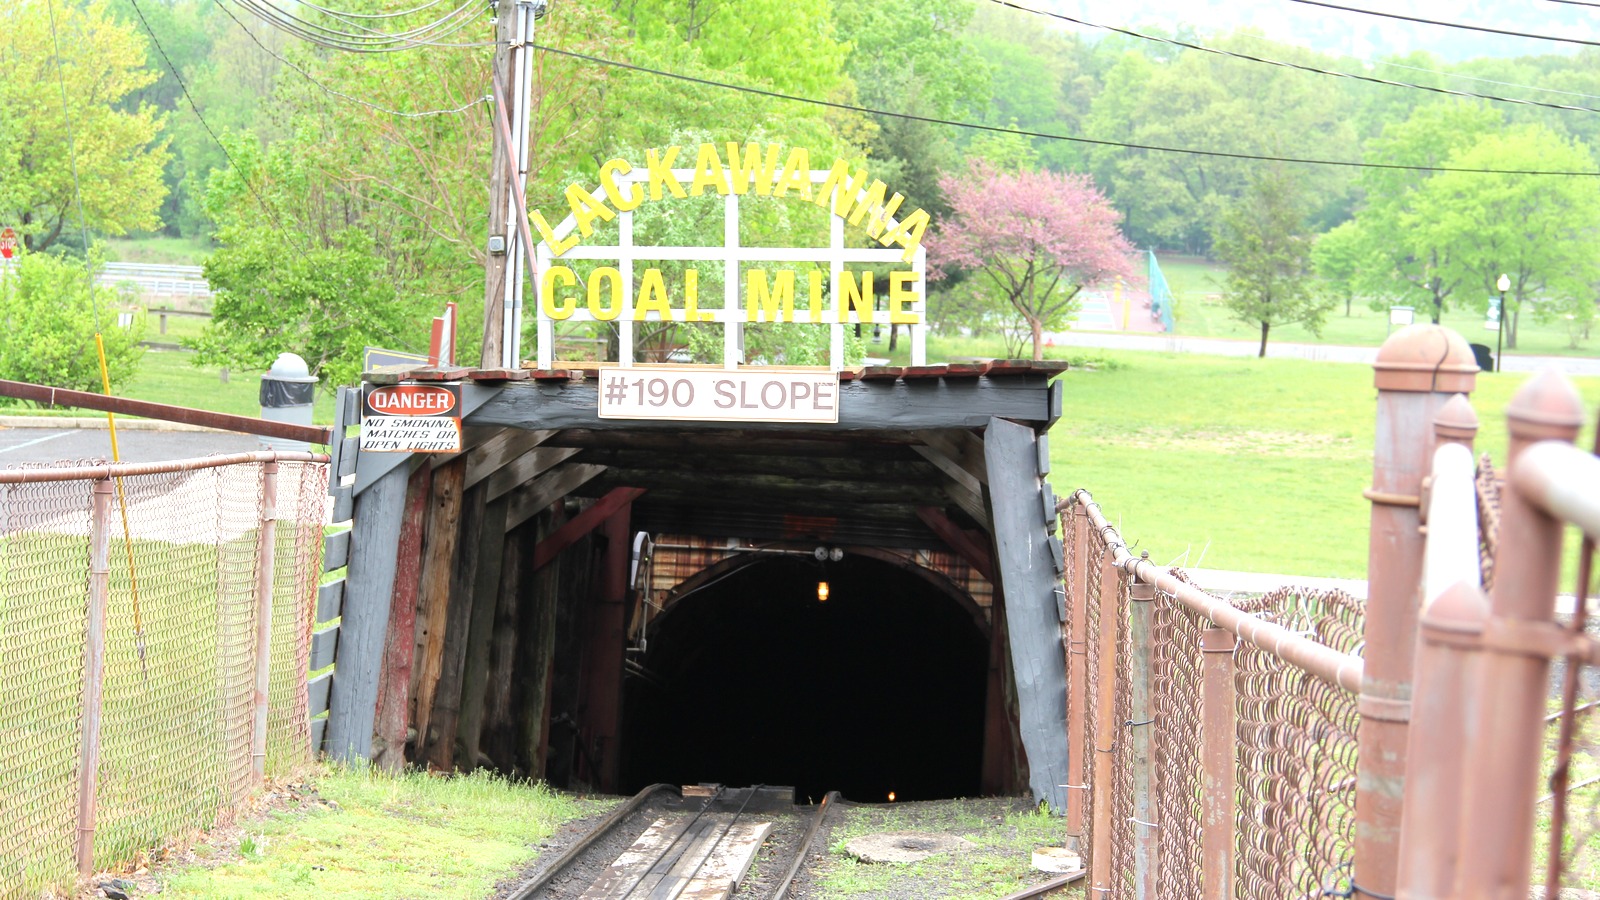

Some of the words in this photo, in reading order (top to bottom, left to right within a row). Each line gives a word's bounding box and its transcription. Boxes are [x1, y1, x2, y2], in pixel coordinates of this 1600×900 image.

[528, 141, 931, 264] LACKAWANNA
[542, 265, 715, 322] COAL
[746, 269, 920, 324] MINE
[375, 392, 449, 409] DANGER
[605, 377, 695, 407] #190
[714, 380, 833, 410] SLOPE
[365, 418, 385, 427] NO
[391, 419, 455, 428] SMOKING
[367, 430, 430, 439] MATCHES
[436, 431, 457, 439] OR
[364, 440, 401, 449] OPEN
[407, 441, 456, 450] LIGHTS
